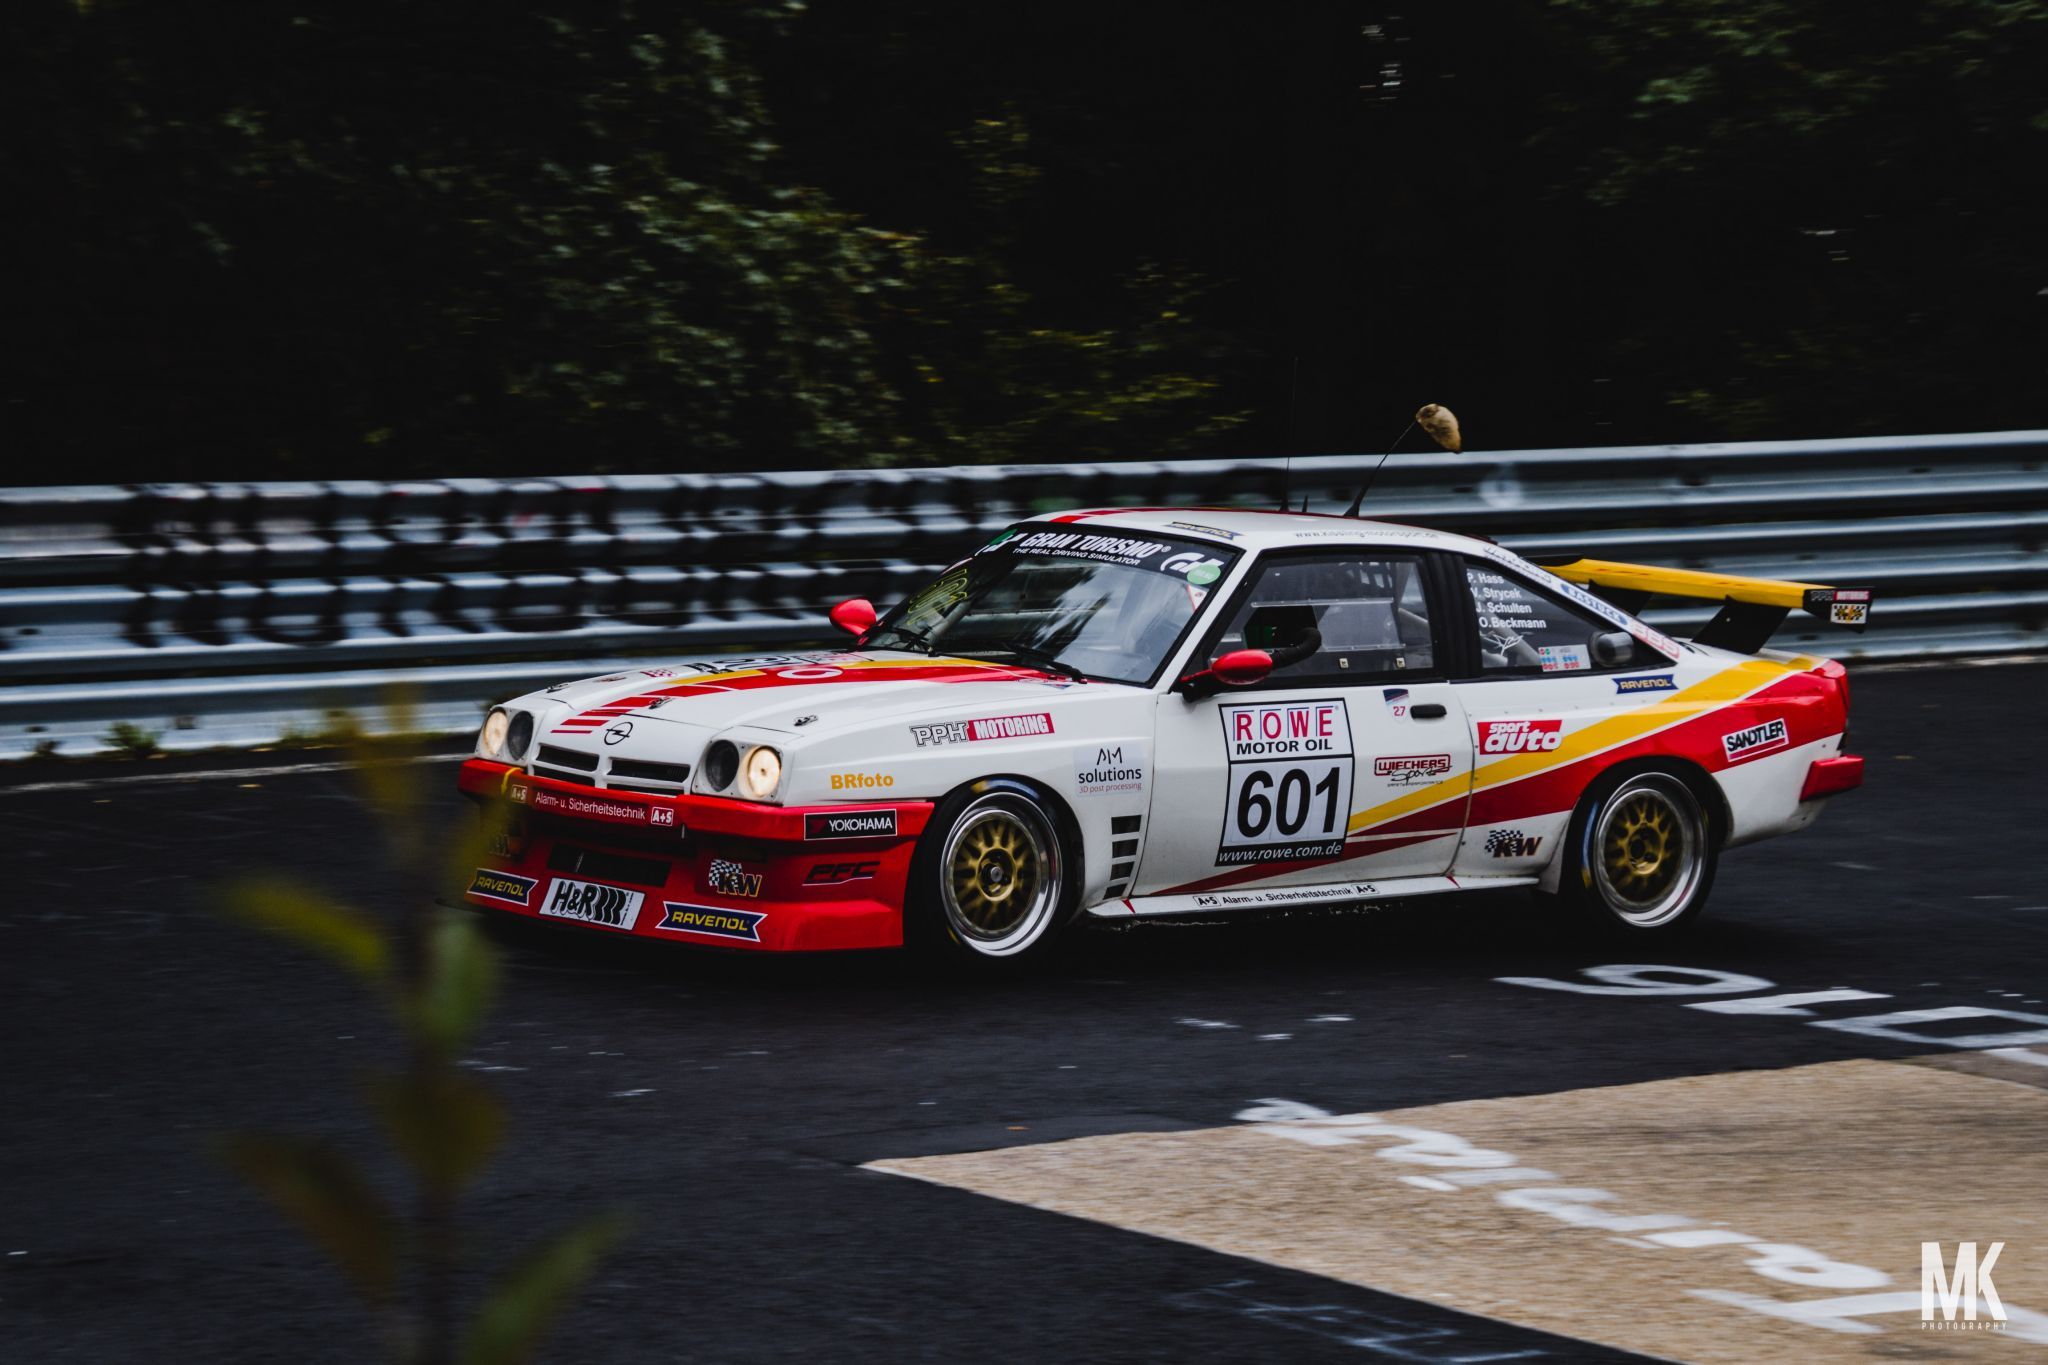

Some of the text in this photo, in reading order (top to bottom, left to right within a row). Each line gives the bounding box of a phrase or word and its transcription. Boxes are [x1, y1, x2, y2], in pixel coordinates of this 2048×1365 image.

[1021, 532, 1077, 549] GRAN
[1027, 548, 1050, 556] REAL
[1051, 549, 1088, 560] DRIVING
[1088, 551, 1141, 566] SIMULATOR
[1466, 572, 1505, 584] P. Hass
[1470, 587, 1522, 601] V. Strycek
[1475, 602, 1533, 613] J. Schulten
[1620, 674, 1672, 691] RAVENOL
[1392, 705, 1406, 717] 27
[909, 714, 1049, 748] PPH MOTORING
[1234, 707, 1334, 742] ROWE
[1488, 720, 1531, 734] sport
[1484, 730, 1563, 753] auto
[1725, 719, 1785, 753] SANDTLER
[1236, 738, 1333, 756] MOTOR OIL
[830, 773, 894, 790] BRfoto
[1078, 767, 1142, 784] solutions
[1089, 784, 1105, 794] post
[1105, 782, 1142, 793] processing
[511, 787, 673, 824] A+S Alarm- u. Sicherheitstechnik A+S
[1236, 766, 1341, 838] 601
[828, 816, 893, 832] YOKOHAMA
[1219, 841, 1343, 862] www.rowe.com.de
[1492, 835, 1543, 858] KW
[803, 860, 881, 884] PFC
[476, 876, 525, 897] RAVENOL
[717, 871, 762, 897] KW
[550, 880, 601, 922] H&R
[1197, 884, 1376, 906] A+S Alarm- u. Sicherheitstechnik A+S
[671, 911, 749, 932] RAVENOL
